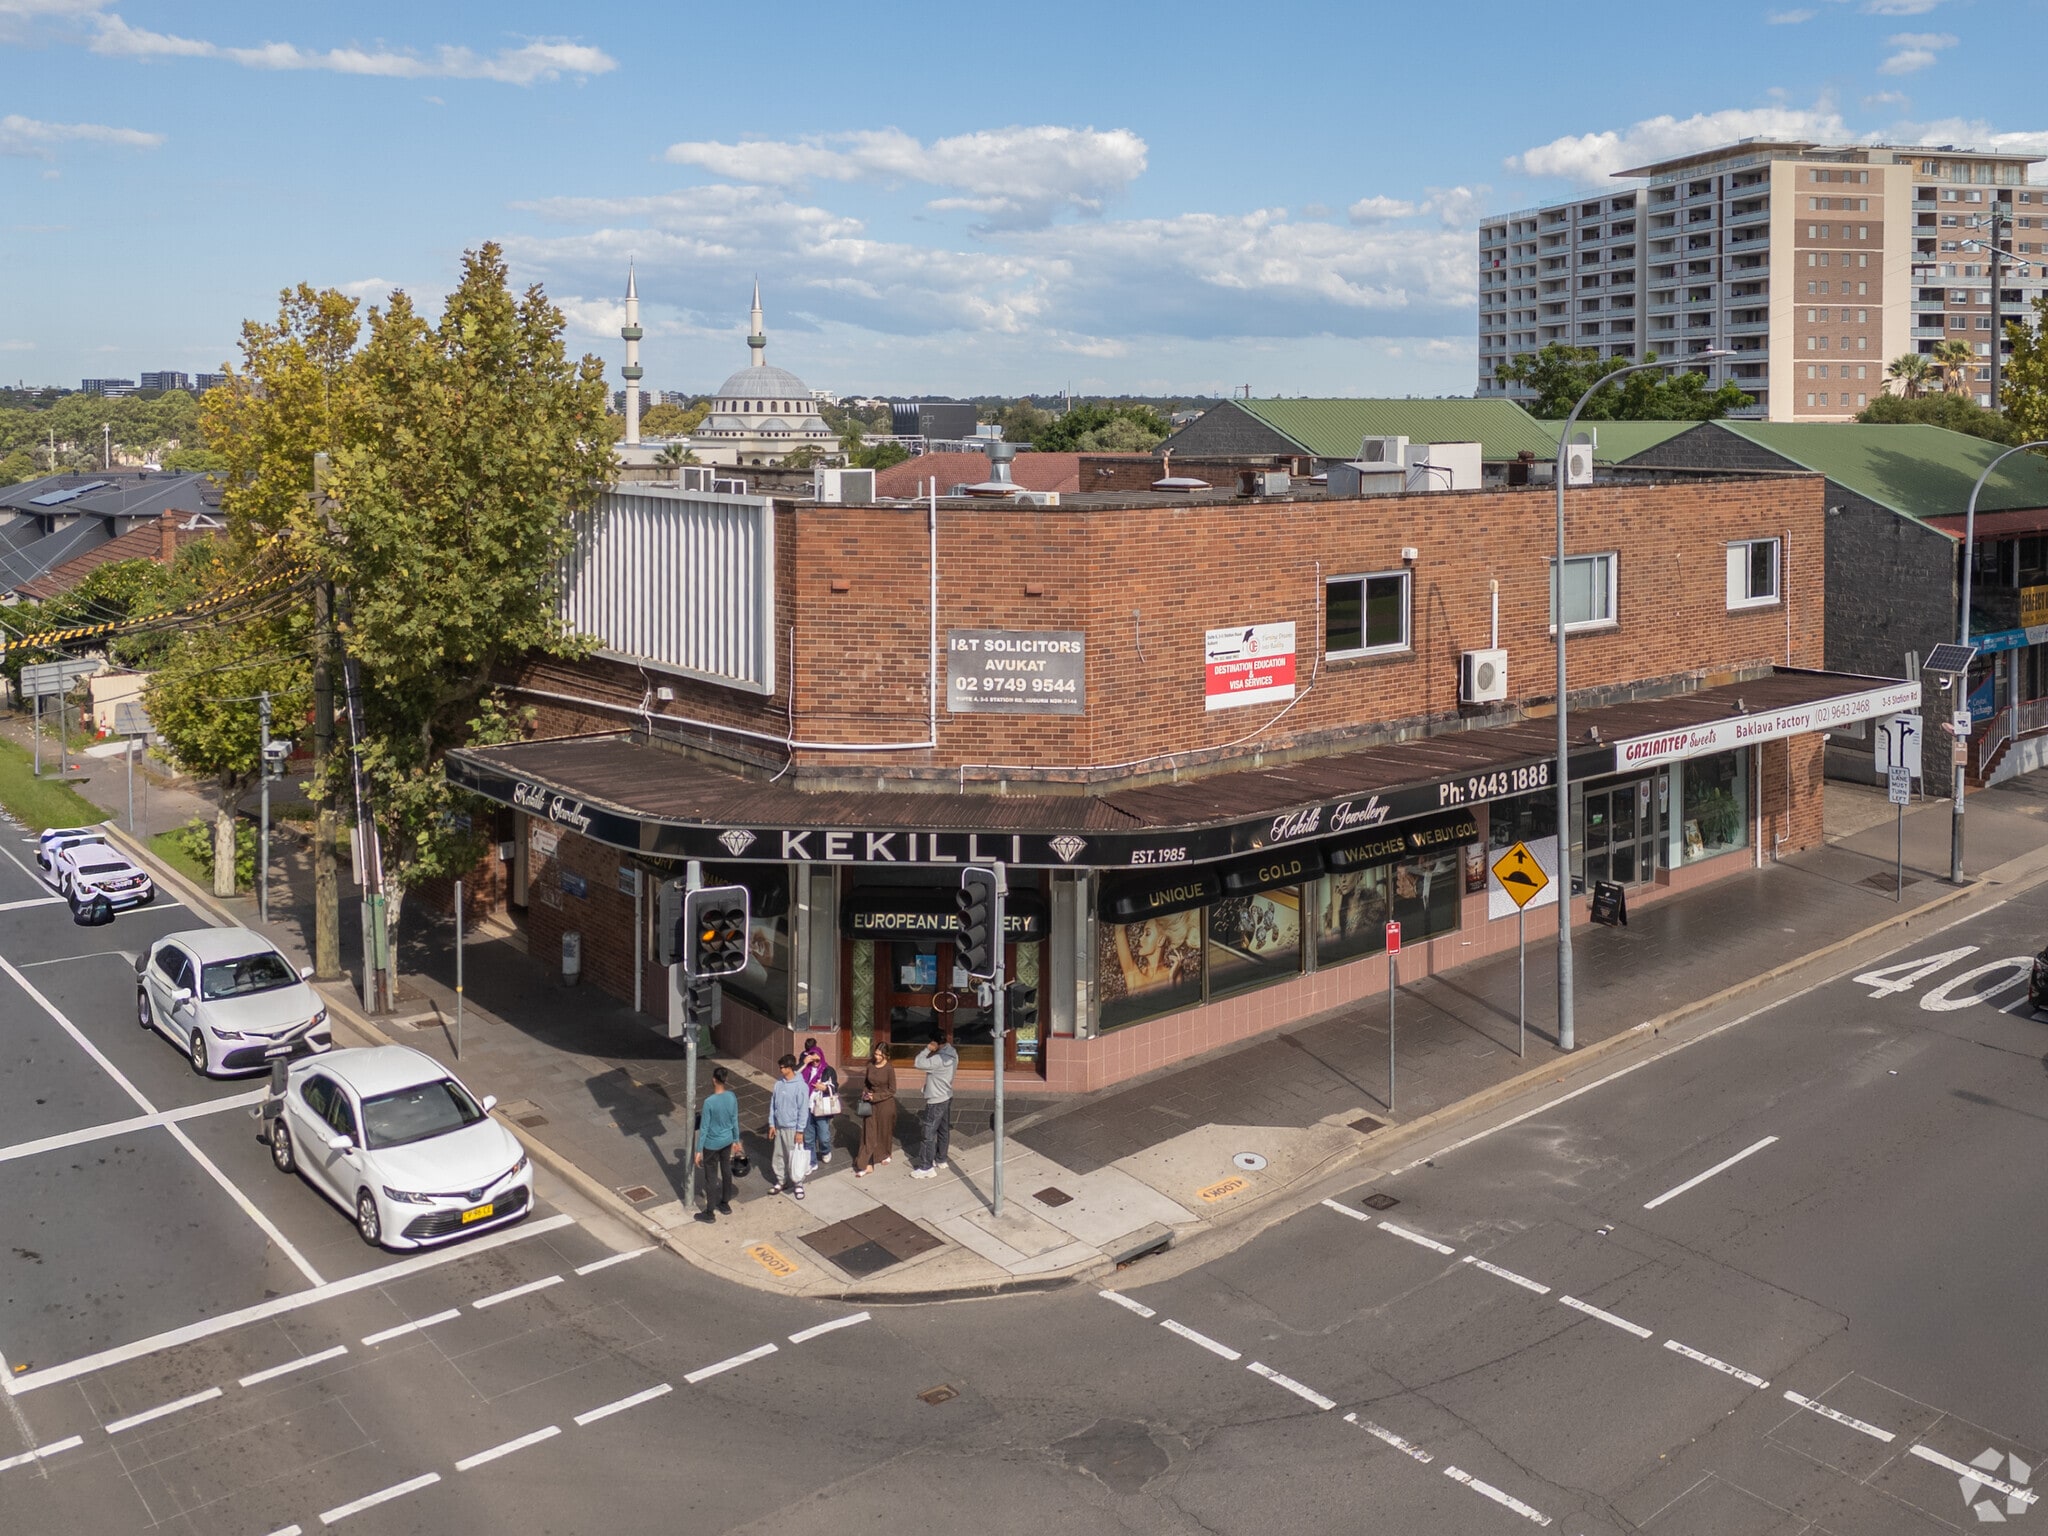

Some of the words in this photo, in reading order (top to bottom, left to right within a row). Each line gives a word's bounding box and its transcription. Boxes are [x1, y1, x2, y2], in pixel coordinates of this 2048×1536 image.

[951, 639, 979, 651] I&T
[984, 639, 1081, 653] SOLICITORS
[985, 659, 1047, 671] AVUKAT
[1214, 661, 1253, 676] DESTINATION
[1253, 657, 1286, 670] EDUCATION
[955, 677, 978, 691] 02
[983, 678, 1027, 692] 9749
[1032, 679, 1076, 692] 9544
[1229, 679, 1244, 690] VISA
[1244, 675, 1273, 688] SERVICES
[1892, 694, 1910, 705] Station
[1815, 706, 1830, 723] (02)
[1831, 703, 1850, 719] 9643
[1852, 699, 1870, 715] 2468
[1736, 720, 1773, 739] Baklava
[1776, 713, 1811, 732] Factory
[1625, 733, 1688, 761] GAZIANTEP
[1690, 728, 1717, 748] Sweets
[1439, 783, 1465, 806] Ph:
[1468, 772, 1508, 799] 9643
[1511, 764, 1548, 791] 1888
[549, 795, 592, 834] Jewellery
[1270, 807, 1321, 841] Kekilli
[1330, 795, 1390, 831] Jewellery
[782, 831, 1020, 863] KEKILLI
[1412, 830, 1435, 847] WE
[1435, 827, 1455, 843] BUY
[1131, 850, 1156, 864] EST.
[1158, 847, 1186, 862] 1985
[1344, 837, 1405, 864] WATCHES
[1258, 860, 1302, 882] GOLD
[1149, 883, 1205, 906] UNIQUE
[854, 913, 938, 929] EUROPEAN
[941, 914, 1033, 931] JEERY
[1852, 945, 2034, 1011] 40
[1209, 1181, 1241, 1197] LOOK
[758, 1250, 785, 1270] LOOK
